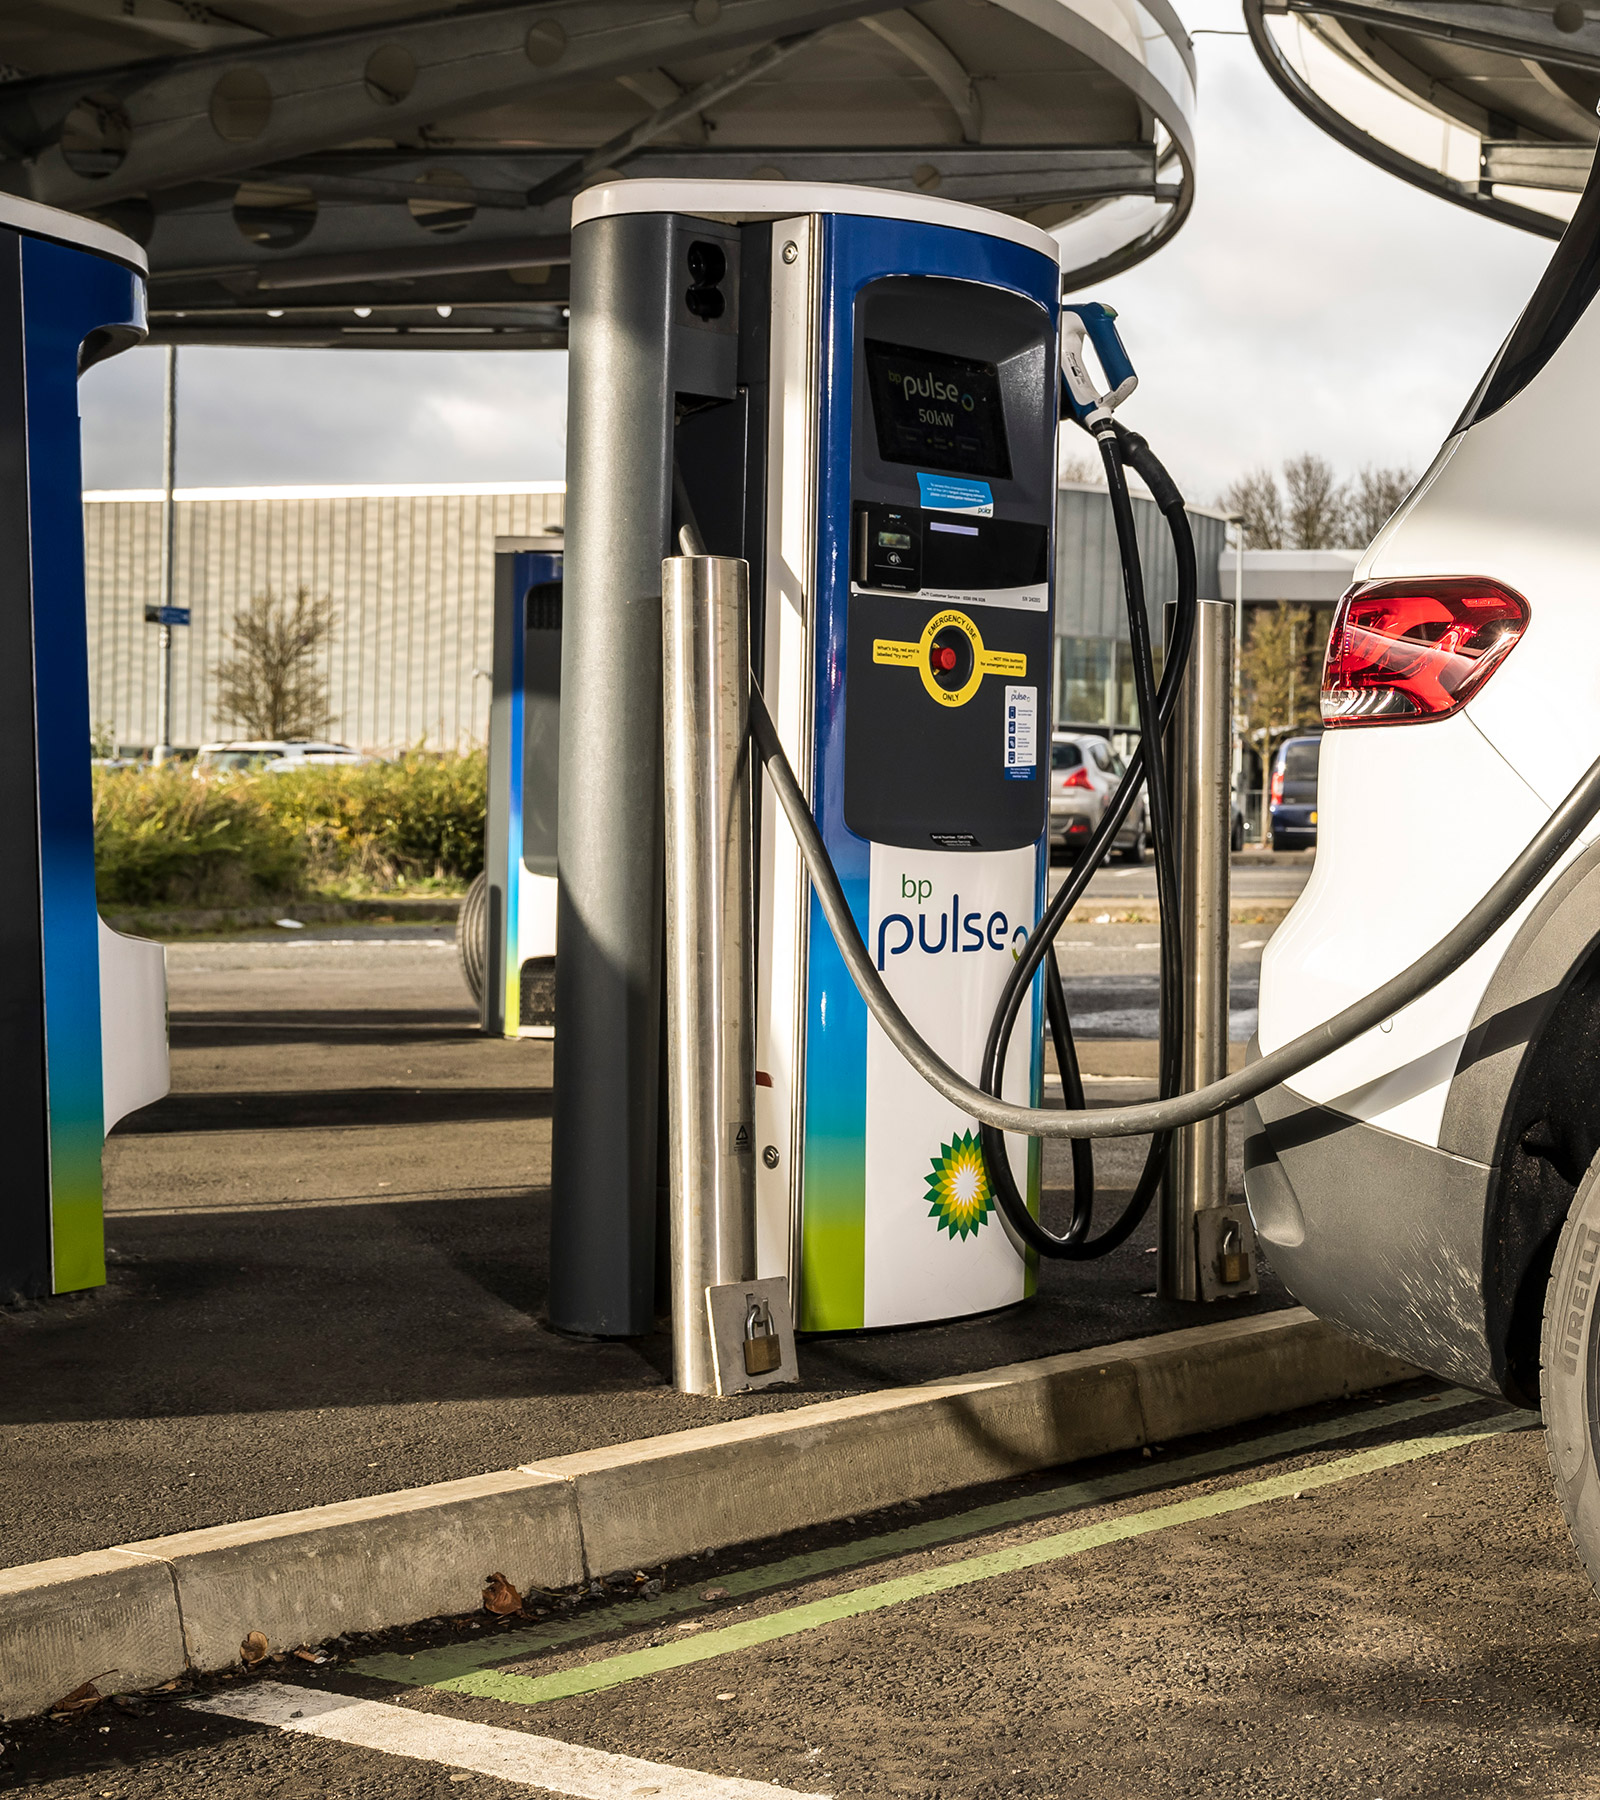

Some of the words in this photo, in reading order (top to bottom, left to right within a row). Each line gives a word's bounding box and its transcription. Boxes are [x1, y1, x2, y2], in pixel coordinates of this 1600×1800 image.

[888, 370, 902, 385] bp
[902, 372, 959, 403] pulse
[918, 408, 955, 428] 50kW
[928, 615, 966, 637] EMERGENCY
[966, 623, 977, 641] USE
[942, 692, 959, 702] ONLY
[1011, 692, 1027, 701] pulse
[902, 874, 932, 904] bp
[877, 894, 1008, 971] pulse
